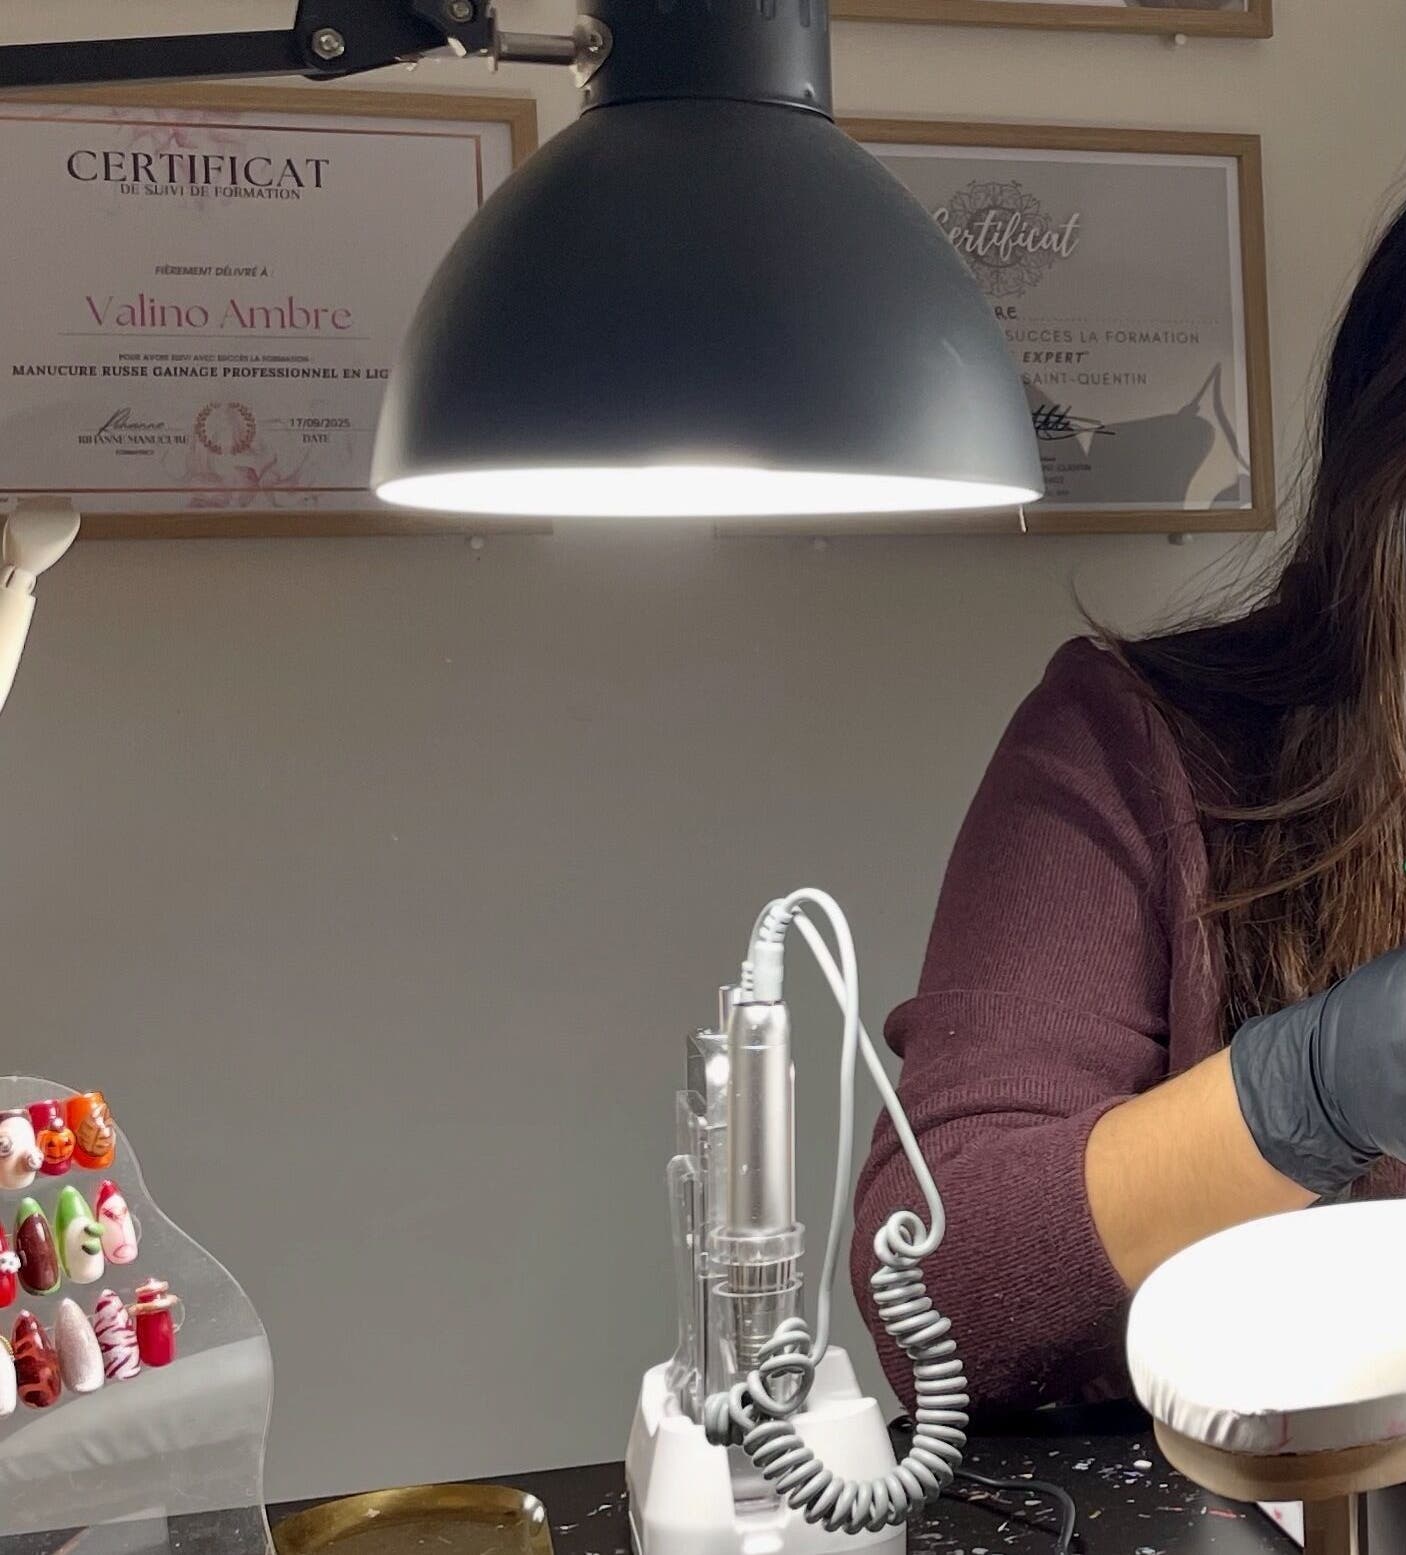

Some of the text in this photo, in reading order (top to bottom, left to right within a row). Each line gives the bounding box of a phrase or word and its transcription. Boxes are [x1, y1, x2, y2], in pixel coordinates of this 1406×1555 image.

[67, 150, 330, 188] CERTIFICAT
[120, 183, 301, 200] DE SUIVI DE FORMATION
[86, 293, 353, 330] Valino Ambre
[1079, 331, 1098, 343] LA
[1104, 331, 1200, 344] FORMATION
[12, 365, 97, 376] MANUCURE
[101, 366, 148, 377] RUSSE
[152, 366, 218, 377] GAINAGE
[223, 367, 339, 379] PROFESSIONNEL
[343, 368, 361, 379] EN
[289, 418, 351, 430] 17/09/2025
